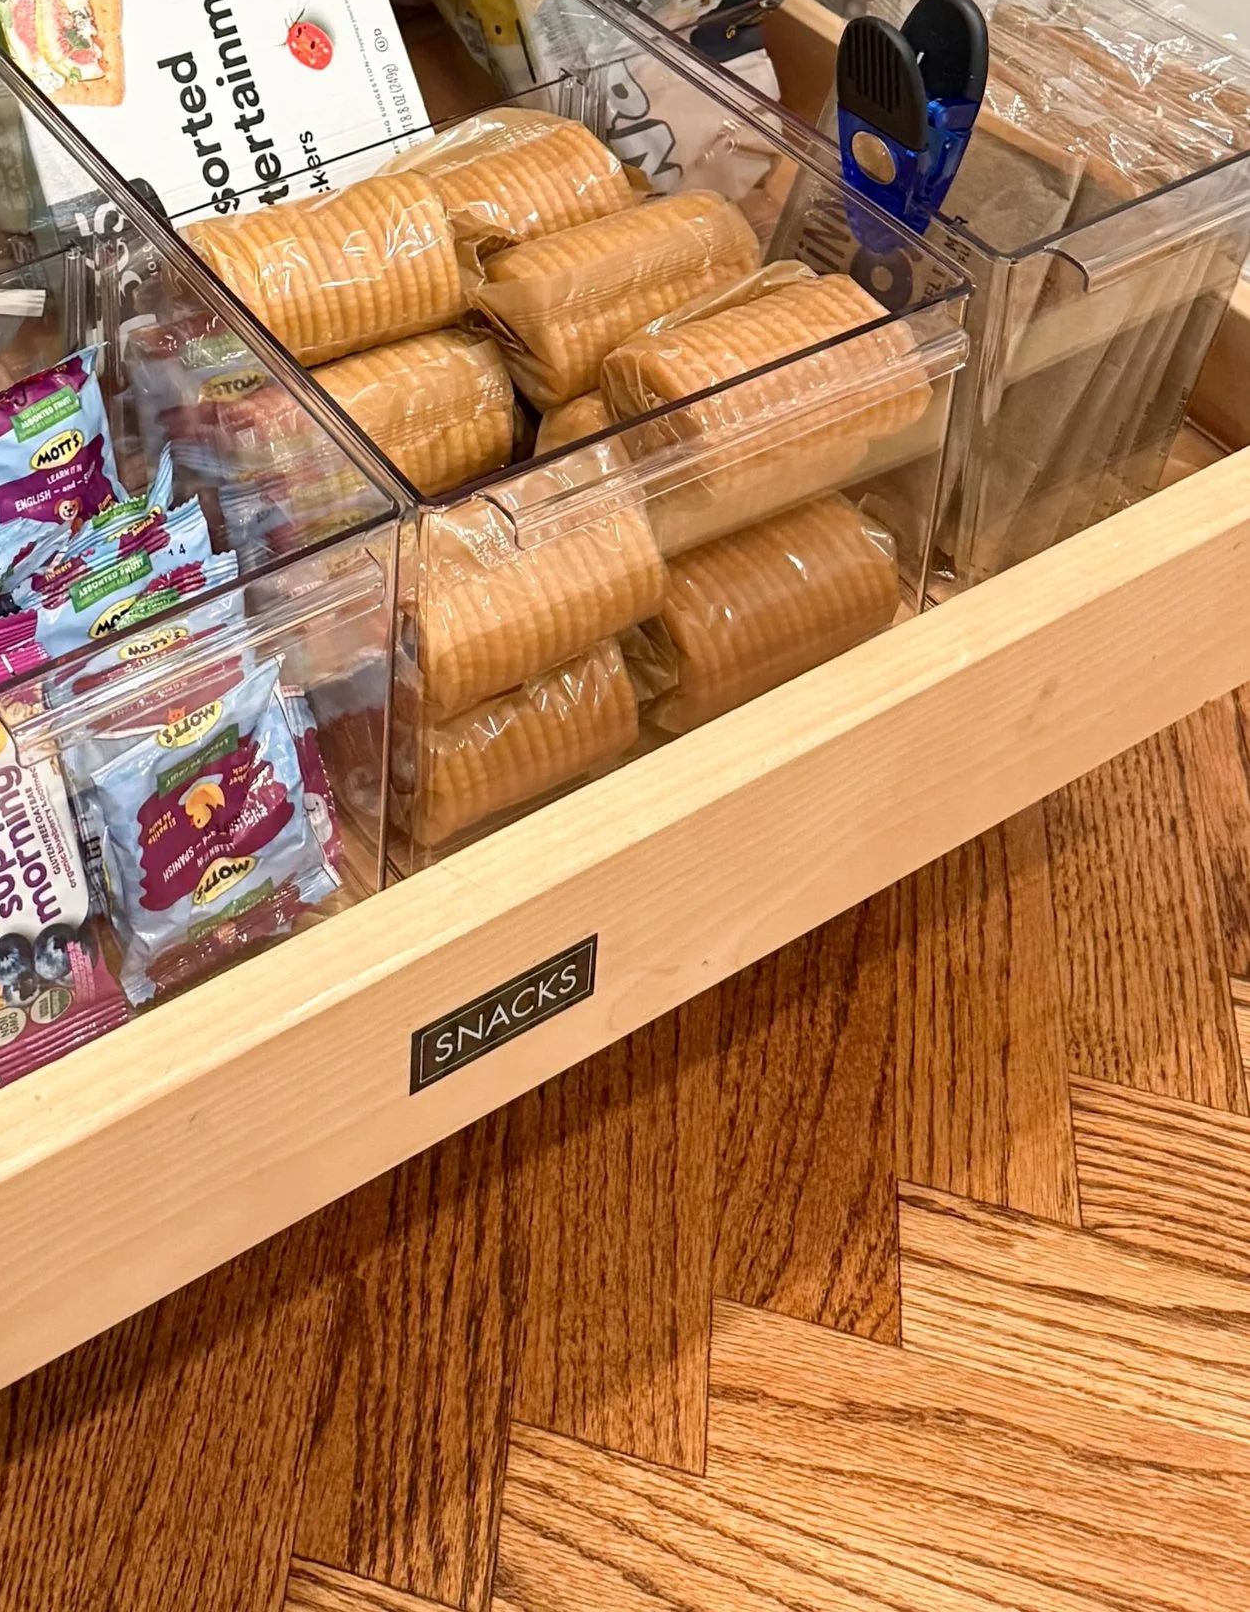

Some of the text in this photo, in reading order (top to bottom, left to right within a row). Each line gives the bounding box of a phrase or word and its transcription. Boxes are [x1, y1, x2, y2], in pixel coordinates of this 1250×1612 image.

[51, 396, 73, 414] FRUIT
[47, 470, 70, 485] LEARN
[14, 491, 52, 513] ENGLISH
[78, 571, 119, 599] ASSORTED
[38, 824, 61, 875] GLUTEN FREE
[44, 809, 77, 888] organic blueberry
[163, 846, 195, 882] SPANISH
[0, 1014, 10, 1039] NON
[435, 964, 578, 1062] SNACKS
